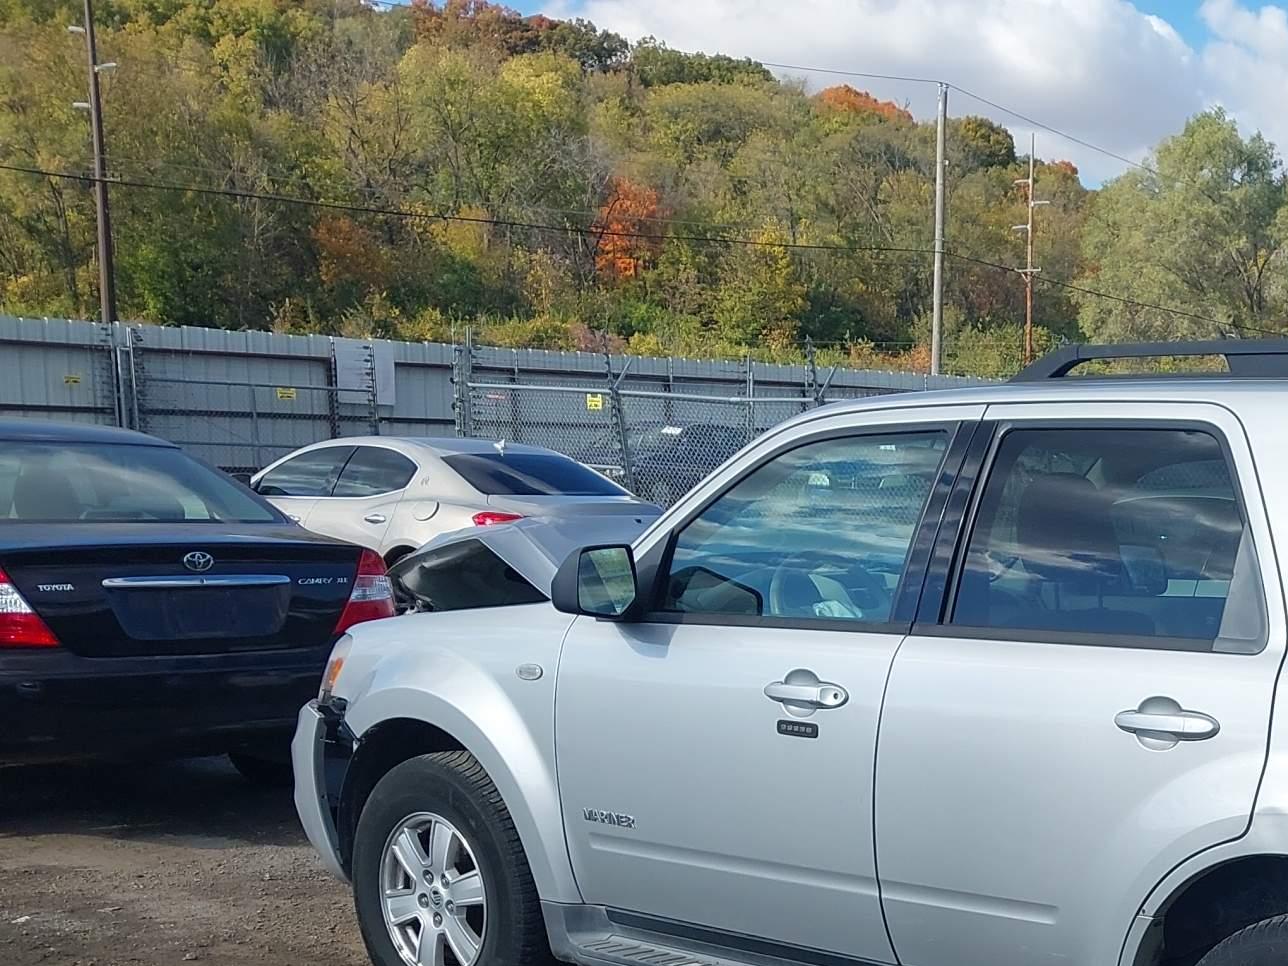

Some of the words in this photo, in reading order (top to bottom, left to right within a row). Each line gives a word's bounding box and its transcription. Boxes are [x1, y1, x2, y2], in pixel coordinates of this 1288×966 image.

[297, 577, 333, 585] CAMRY
[37, 583, 75, 592] TOYOTA
[583, 806, 637, 829] MARINER
